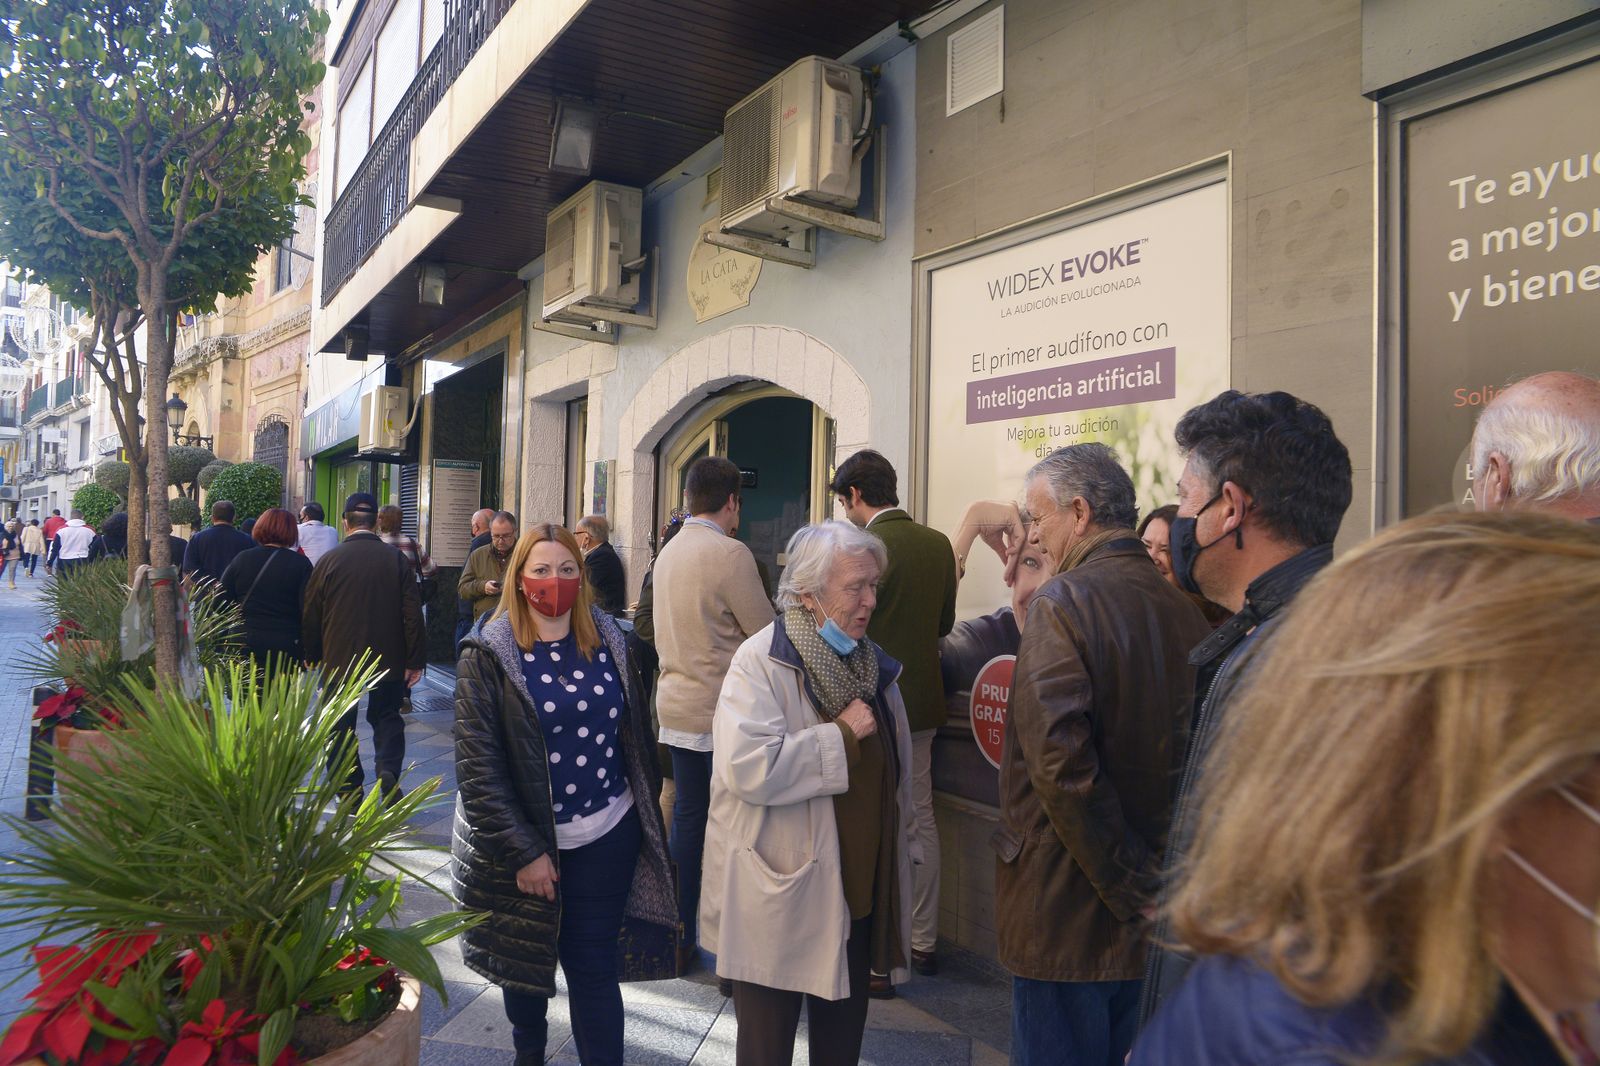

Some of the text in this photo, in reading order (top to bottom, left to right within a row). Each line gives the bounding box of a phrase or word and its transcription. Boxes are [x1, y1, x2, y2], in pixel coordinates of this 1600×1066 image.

[1449, 174, 1497, 209] Te
[1448, 237, 1469, 262] a
[701, 258, 738, 285] LA CATA
[988, 264, 1055, 301] WIDEX
[1001, 276, 1141, 318] LA AUDICIÓN EVOLUCIONADA
[1448, 288, 1471, 322] y
[972, 322, 1169, 374] El primer audífono con
[976, 361, 1162, 410] inteligencia artificial
[1454, 385, 1505, 408] Soli
[1007, 416, 1119, 443] Mejora tu audición
[981, 683, 1010, 703] PRU
